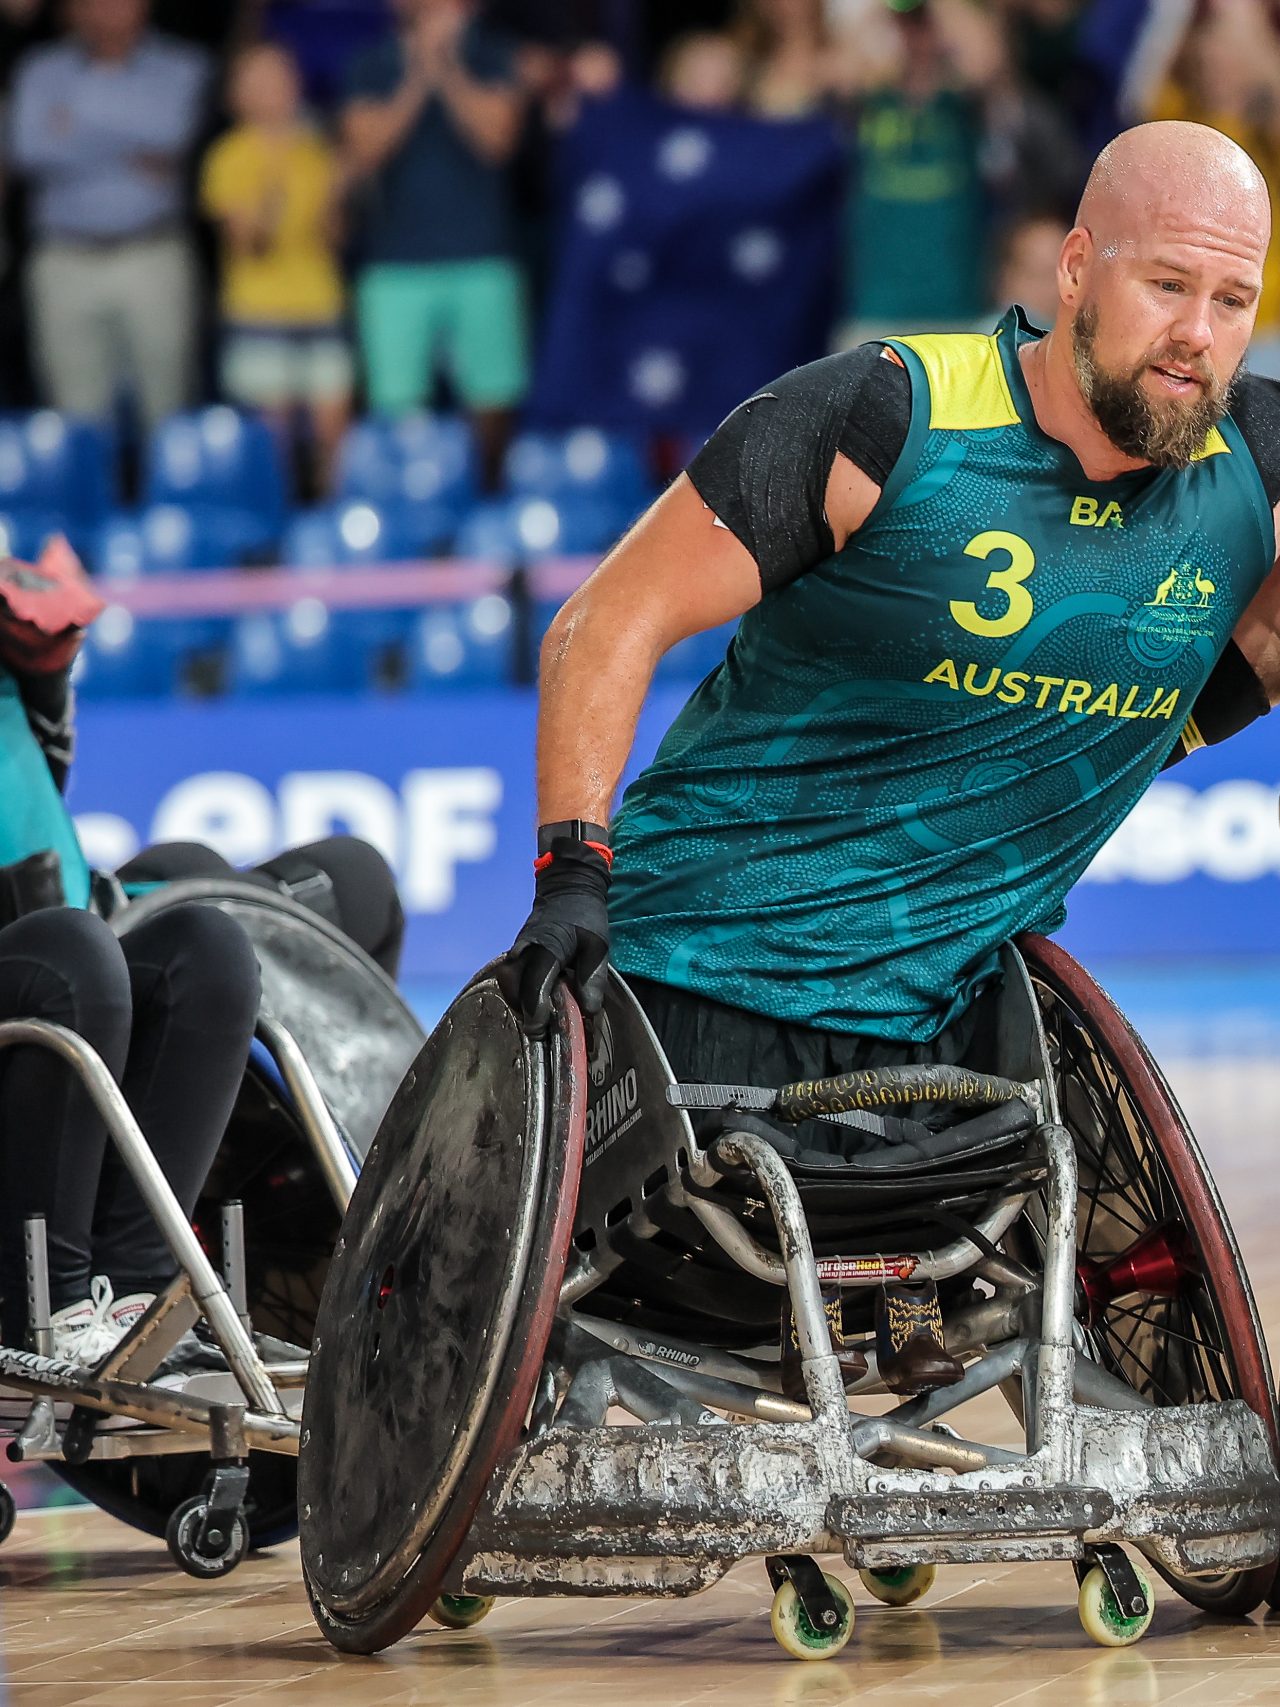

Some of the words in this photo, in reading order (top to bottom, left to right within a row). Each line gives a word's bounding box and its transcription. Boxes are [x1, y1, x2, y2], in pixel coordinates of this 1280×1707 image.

[949, 530, 1036, 638] 3
[923, 658, 1181, 720] AUSTRALIA
[585, 1067, 638, 1151] RHINO
[656, 1345, 700, 1367] RHINO
